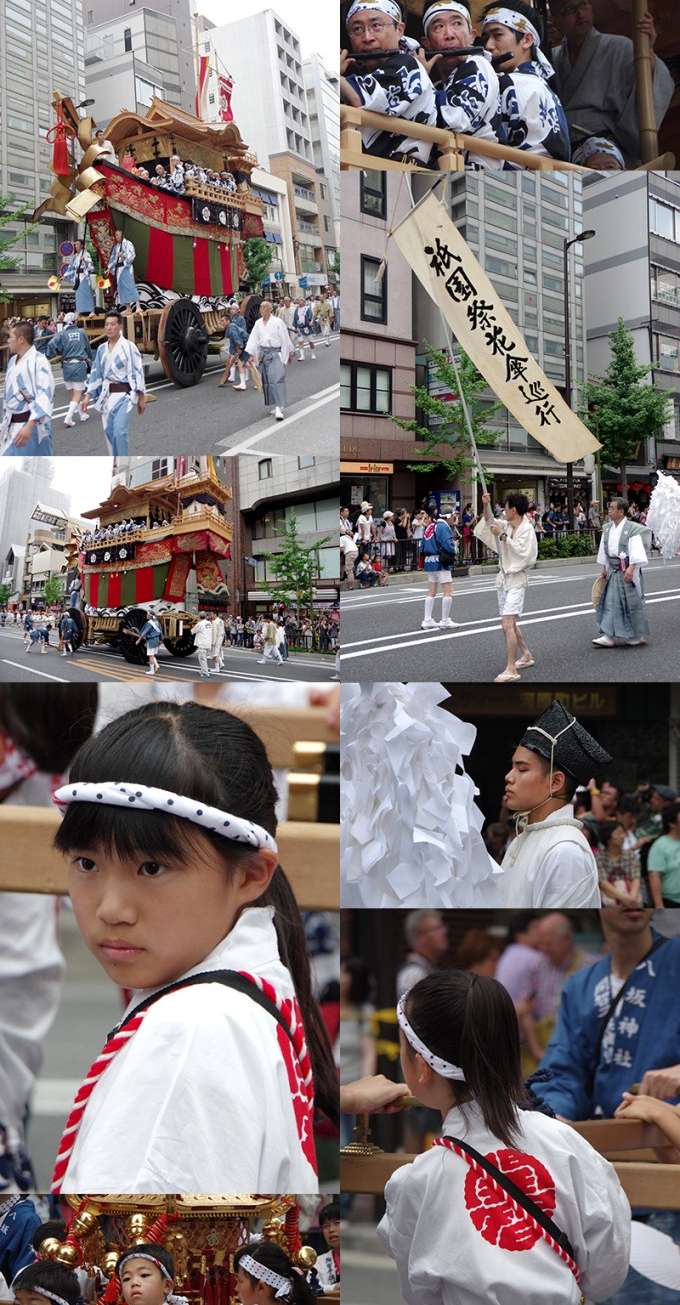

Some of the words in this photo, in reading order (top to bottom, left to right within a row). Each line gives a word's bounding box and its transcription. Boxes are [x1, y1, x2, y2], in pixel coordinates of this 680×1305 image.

[423, 237, 562, 427] 祇園祭花傘巡行
[613, 959, 657, 1069] 八坂神社
